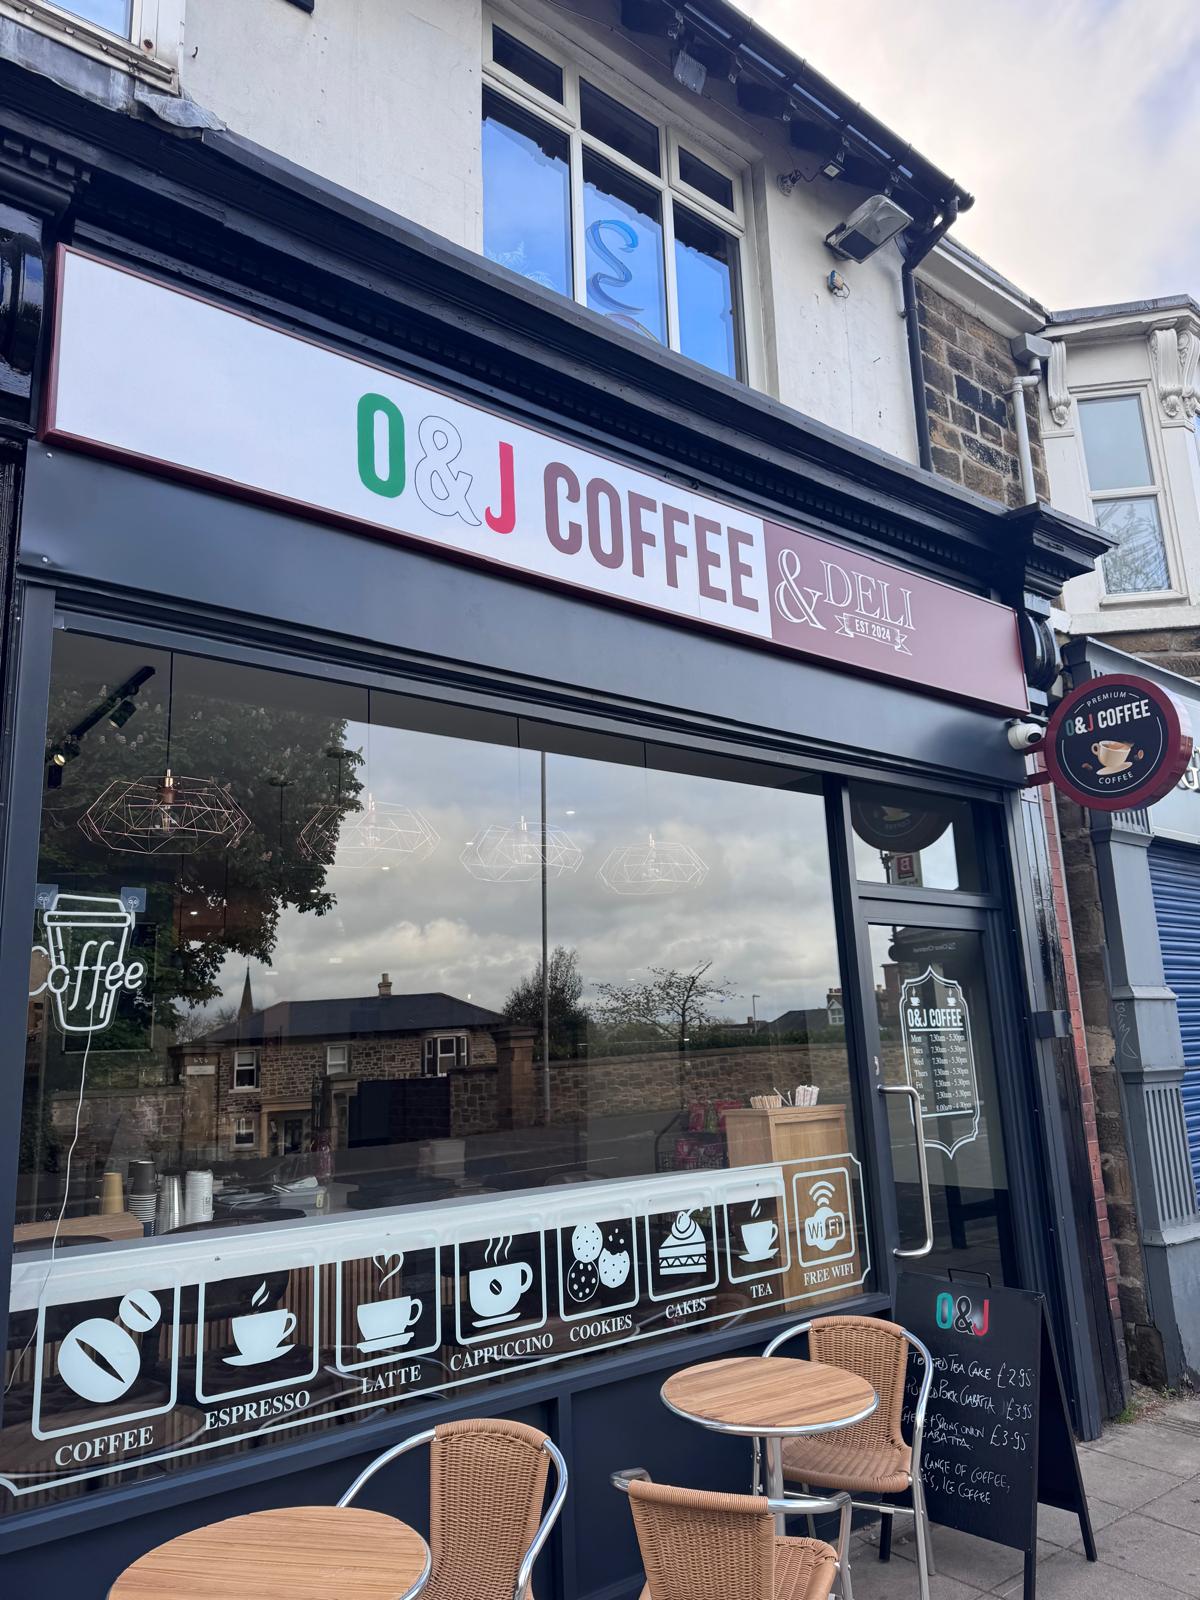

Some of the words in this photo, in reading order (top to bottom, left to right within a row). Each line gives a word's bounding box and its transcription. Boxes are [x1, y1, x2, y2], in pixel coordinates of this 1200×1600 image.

[357, 392, 517, 535] O&J
[543, 461, 759, 613] COFFEE
[774, 548, 827, 631] &
[819, 559, 916, 631] DELI
[855, 619, 869, 635] EST
[871, 624, 891, 641] 2024
[1086, 691, 1127, 708] PREMIUM
[1065, 713, 1094, 737] O&J
[1097, 699, 1151, 729] COFFEE
[1098, 771, 1134, 785] COFFEE
[907, 1008, 928, 1027] O&J
[929, 1008, 963, 1027] COFFEE
[803, 1267, 830, 1286] FREE
[831, 1262, 855, 1279] WIFI
[750, 1282, 773, 1299] TEA
[665, 1296, 707, 1320] CAKES
[935, 1292, 990, 1337] O&J
[569, 1313, 633, 1343] COOKIES
[449, 1332, 554, 1372] CAPPUCCINO
[361, 1364, 422, 1395] LATTE
[948, 1354, 965, 1375] TEA
[967, 1360, 992, 1380] CAKE
[939, 1379, 959, 1404] PORK
[203, 1389, 310, 1431] ESPRESSO
[54, 1425, 154, 1467] COFFEE
[924, 1453, 951, 1475] RANGE
[954, 1463, 968, 1477] OF
[942, 1476, 956, 1495] ICE
[958, 1482, 991, 1504] COFFEE
